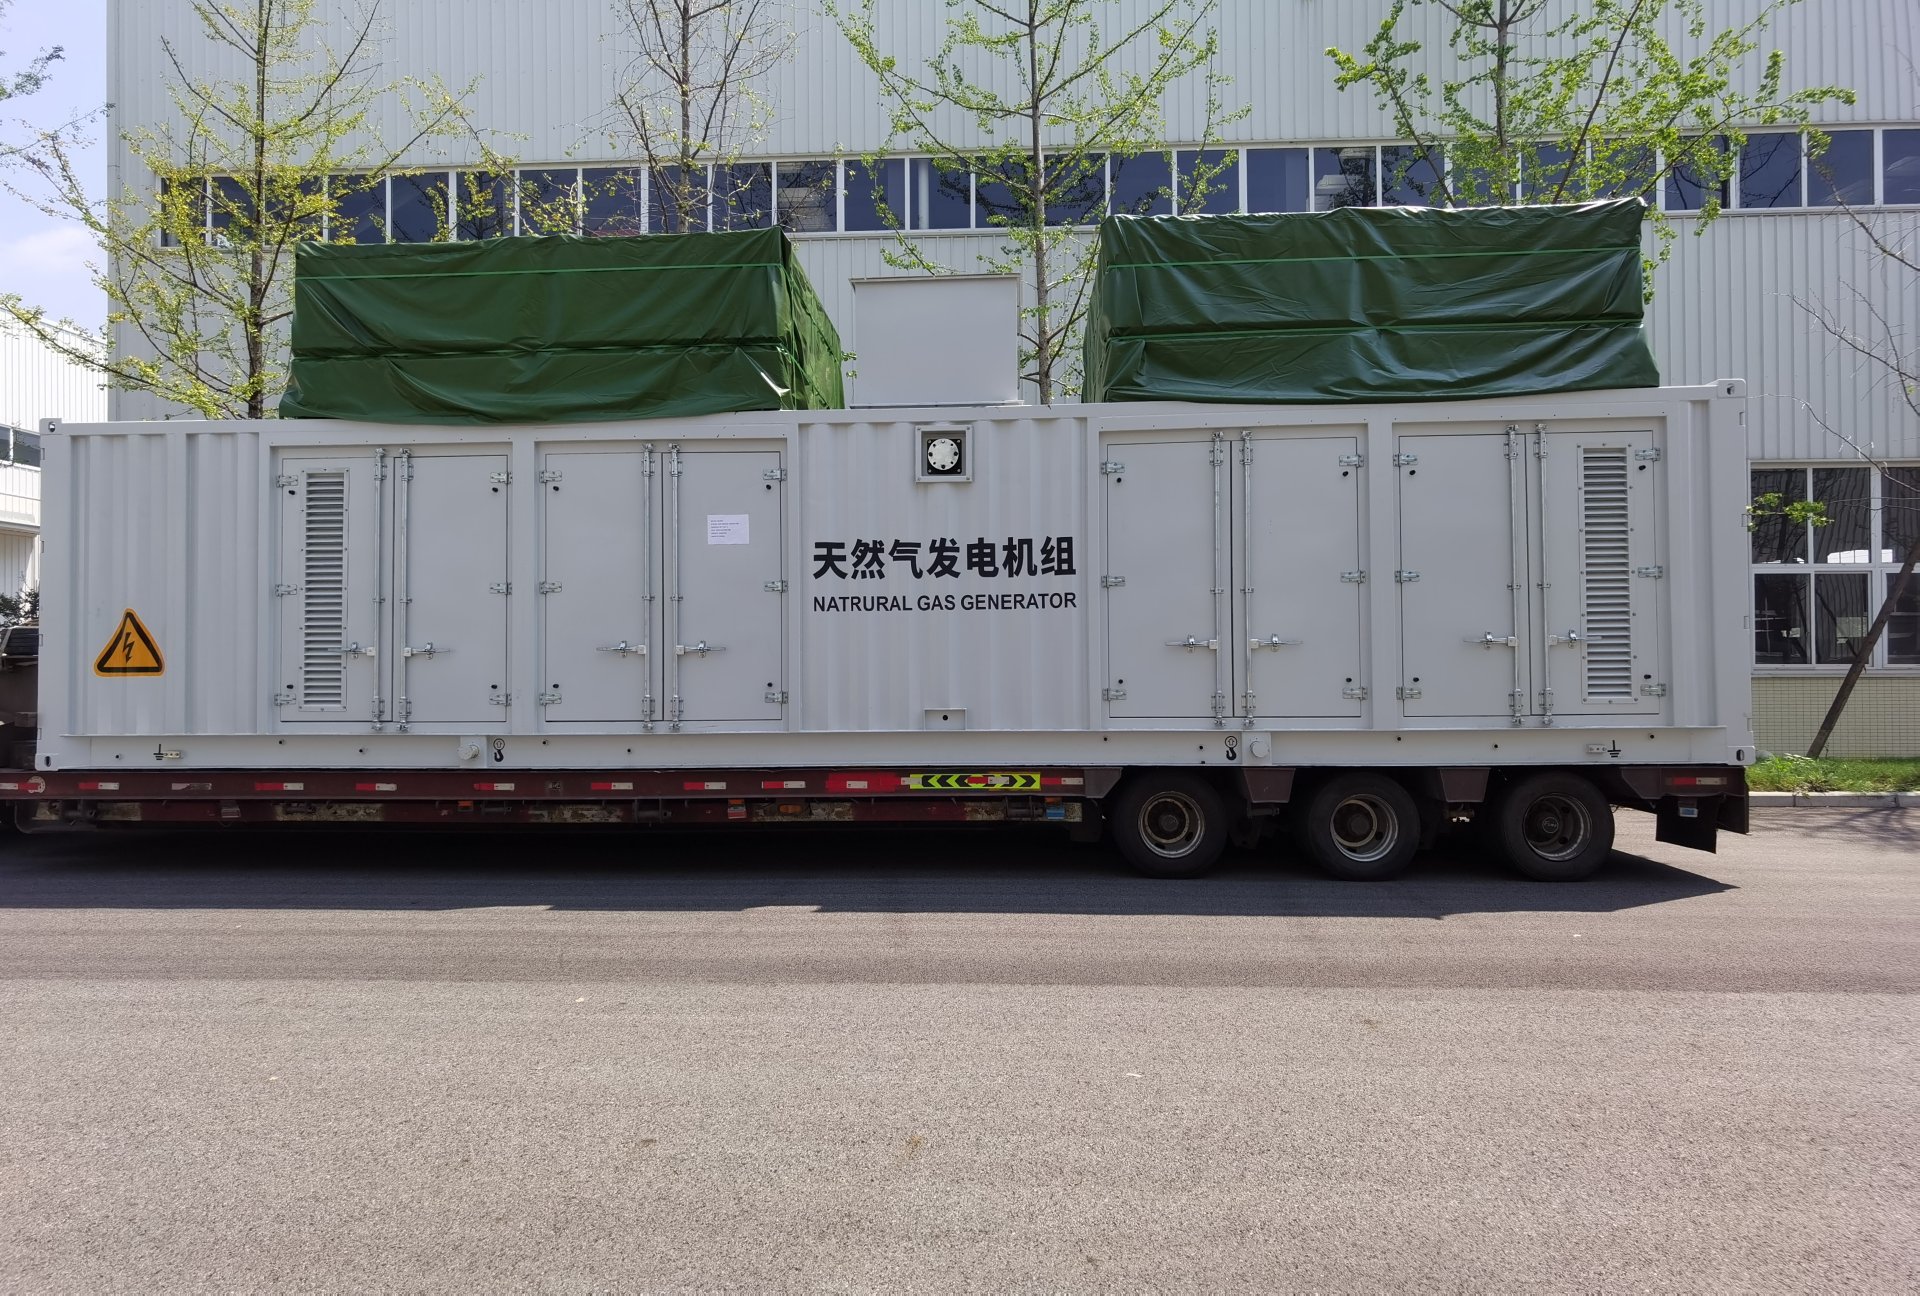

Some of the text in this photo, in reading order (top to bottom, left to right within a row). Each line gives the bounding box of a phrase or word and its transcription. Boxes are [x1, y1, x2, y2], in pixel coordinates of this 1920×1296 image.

[812, 536, 1077, 580] 天然气发电机组
[813, 592, 1077, 612] NATRURAL GAS GENERATOR
